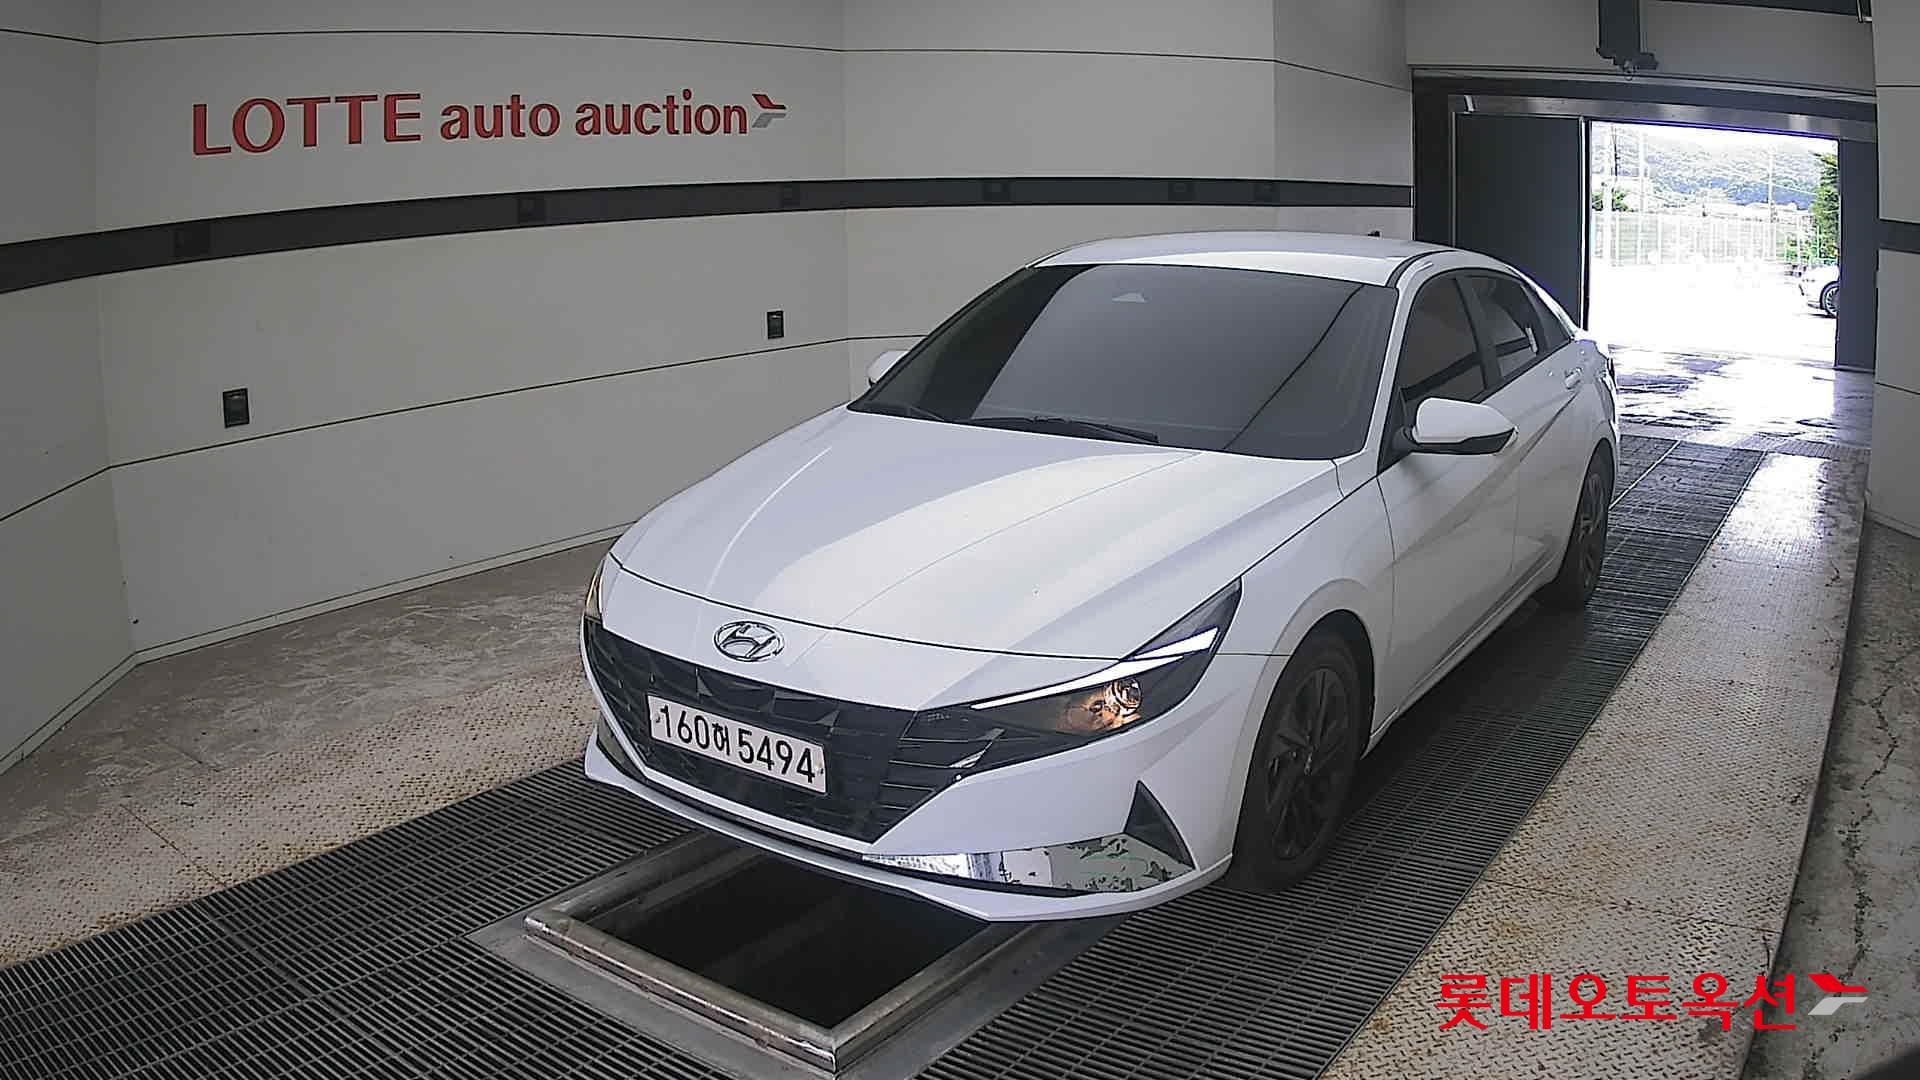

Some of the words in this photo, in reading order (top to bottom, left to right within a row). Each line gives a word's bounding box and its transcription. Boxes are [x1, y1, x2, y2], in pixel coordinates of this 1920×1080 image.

[192, 93, 422, 156] LOTTE
[440, 94, 561, 140] auto
[575, 89, 748, 136] auction
[659, 704, 731, 757] 160허
[737, 727, 816, 784] 5494
